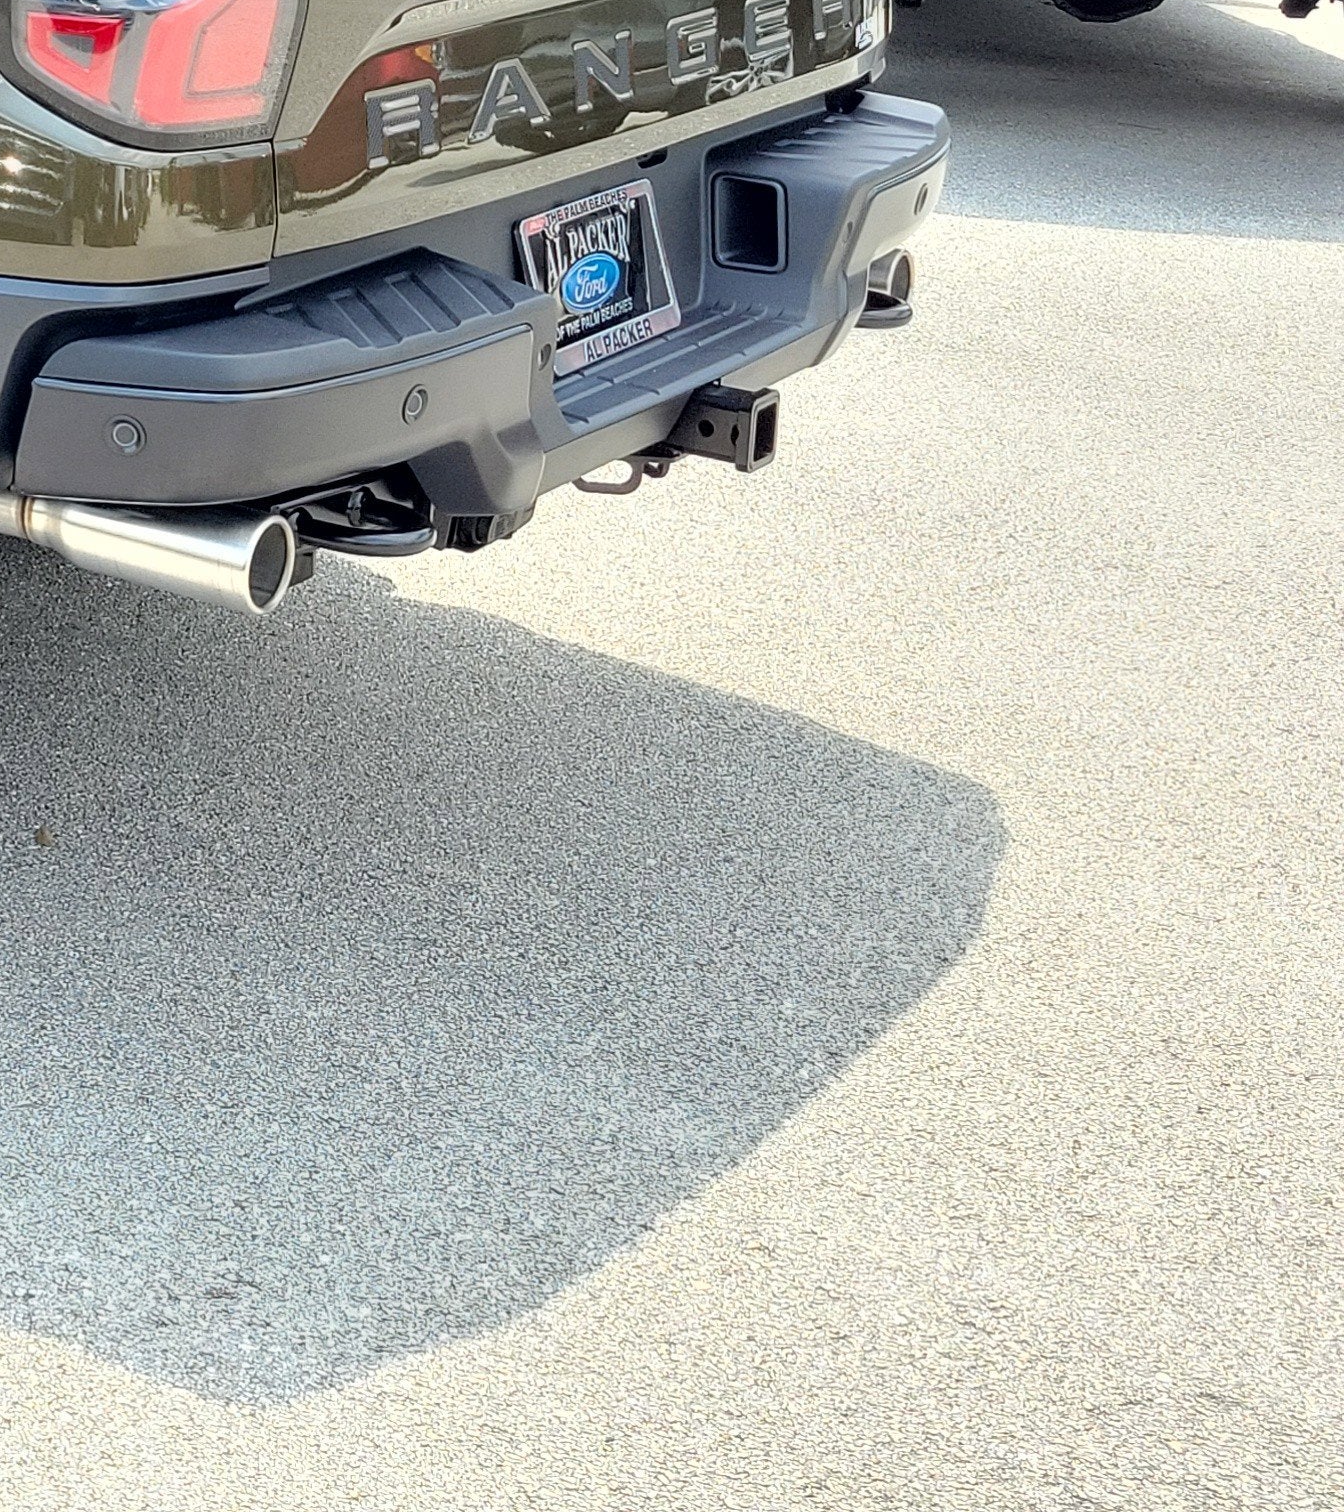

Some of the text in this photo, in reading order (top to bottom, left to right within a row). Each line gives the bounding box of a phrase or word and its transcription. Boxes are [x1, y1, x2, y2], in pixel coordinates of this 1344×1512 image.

[545, 190, 628, 224] THE PALM BEACHES
[545, 213, 631, 294] AL PACKER
[575, 263, 608, 303] Ford
[565, 320, 581, 337] THE
[580, 313, 600, 330] PALM
[601, 297, 633, 322] BEACHES
[586, 318, 653, 362] AL PACKER
